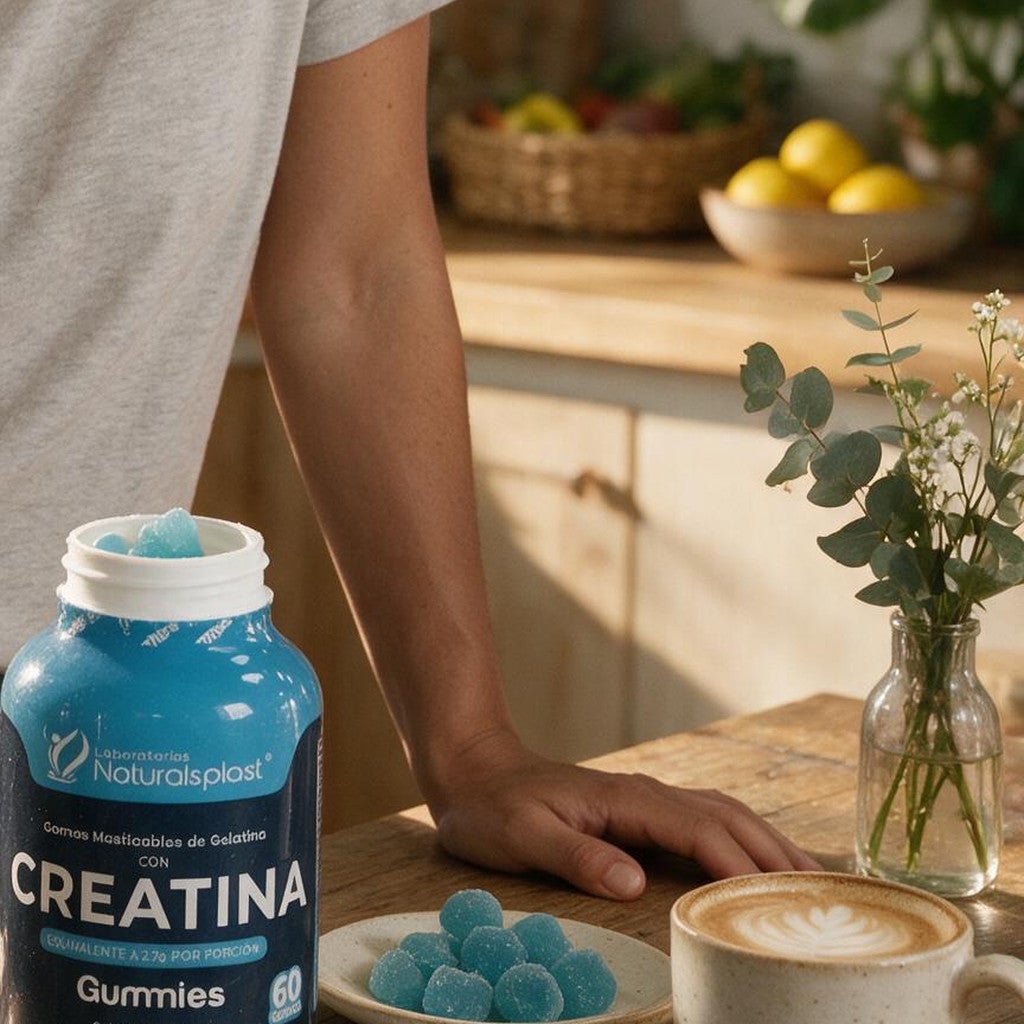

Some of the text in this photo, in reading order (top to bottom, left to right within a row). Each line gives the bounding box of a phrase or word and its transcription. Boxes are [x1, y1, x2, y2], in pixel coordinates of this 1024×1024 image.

[187, 834, 206, 848] de
[138, 856, 169, 869] CON
[11, 851, 307, 930] CREATINA
[77, 975, 226, 1009] Gummies
[272, 968, 302, 1009] 60
